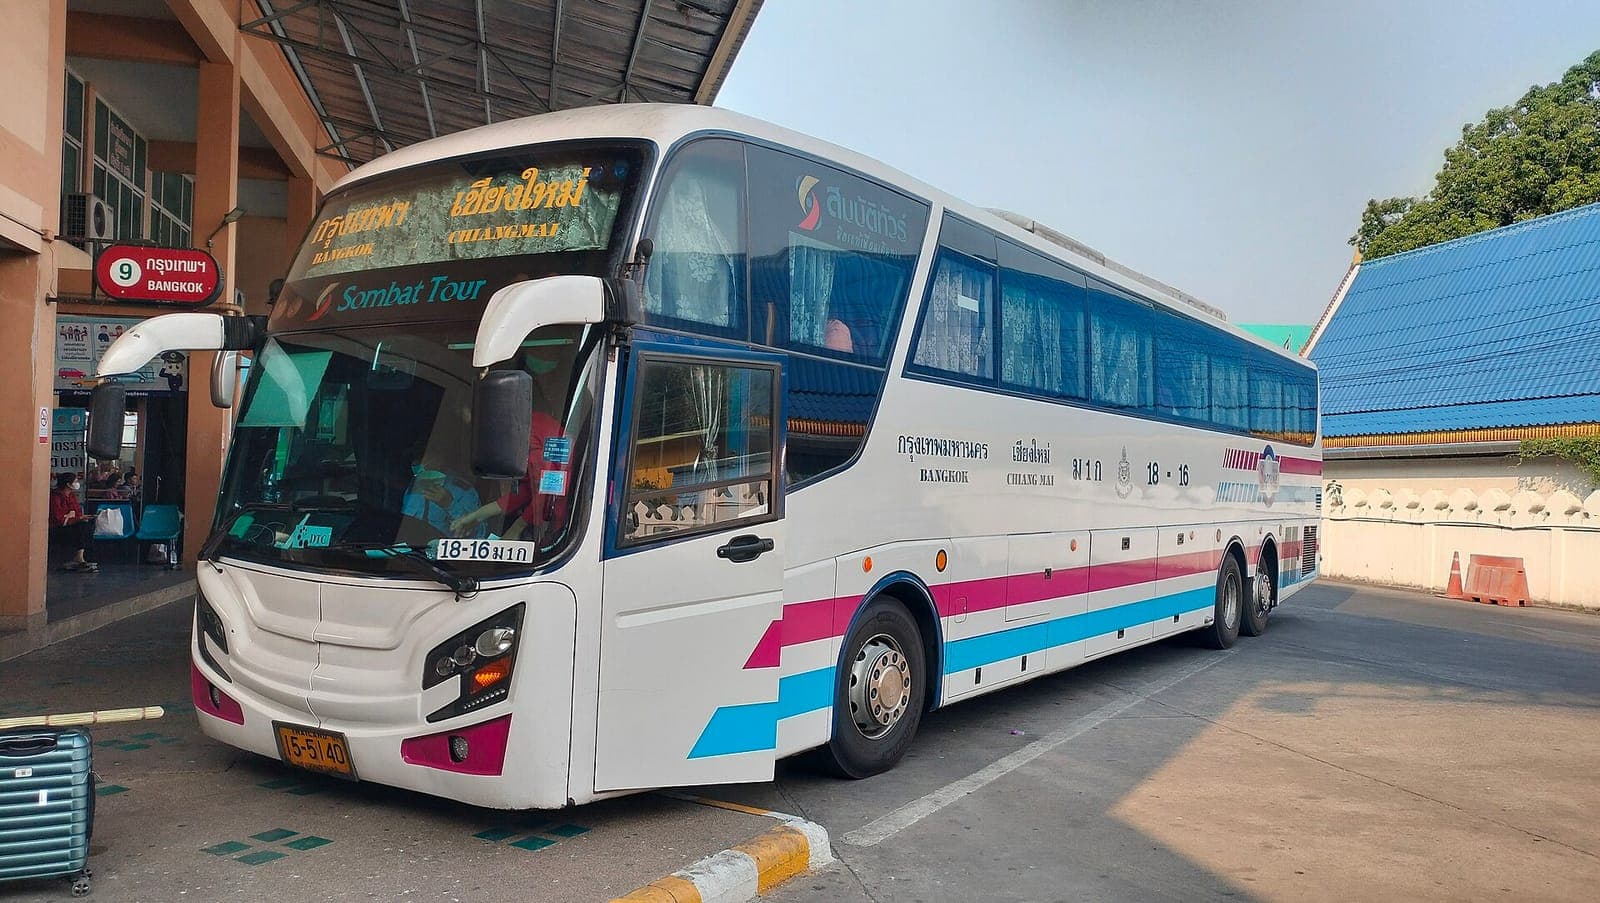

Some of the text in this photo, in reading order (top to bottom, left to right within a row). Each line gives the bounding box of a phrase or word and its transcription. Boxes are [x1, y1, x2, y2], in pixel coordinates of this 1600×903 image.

[450, 167, 592, 217] เชียงใหม่
[311, 200, 410, 249] กรุงเทพฯ
[448, 222, 560, 244] CHIANGMAI
[312, 243, 374, 265] BANGKOK
[119, 263, 132, 280] 9
[146, 258, 206, 276] กรุงเทพฯ
[147, 280, 203, 293] BANGKOK
[337, 275, 487, 312] Sombat Tour
[897, 435, 988, 463] กรุงเทพมหานคร
[1012, 438, 1051, 464] เชียงใหม่
[919, 468, 969, 483] BANGKOK
[1006, 473, 1055, 486] CHIANG MAI
[284, 734, 345, 764] 15-5140
